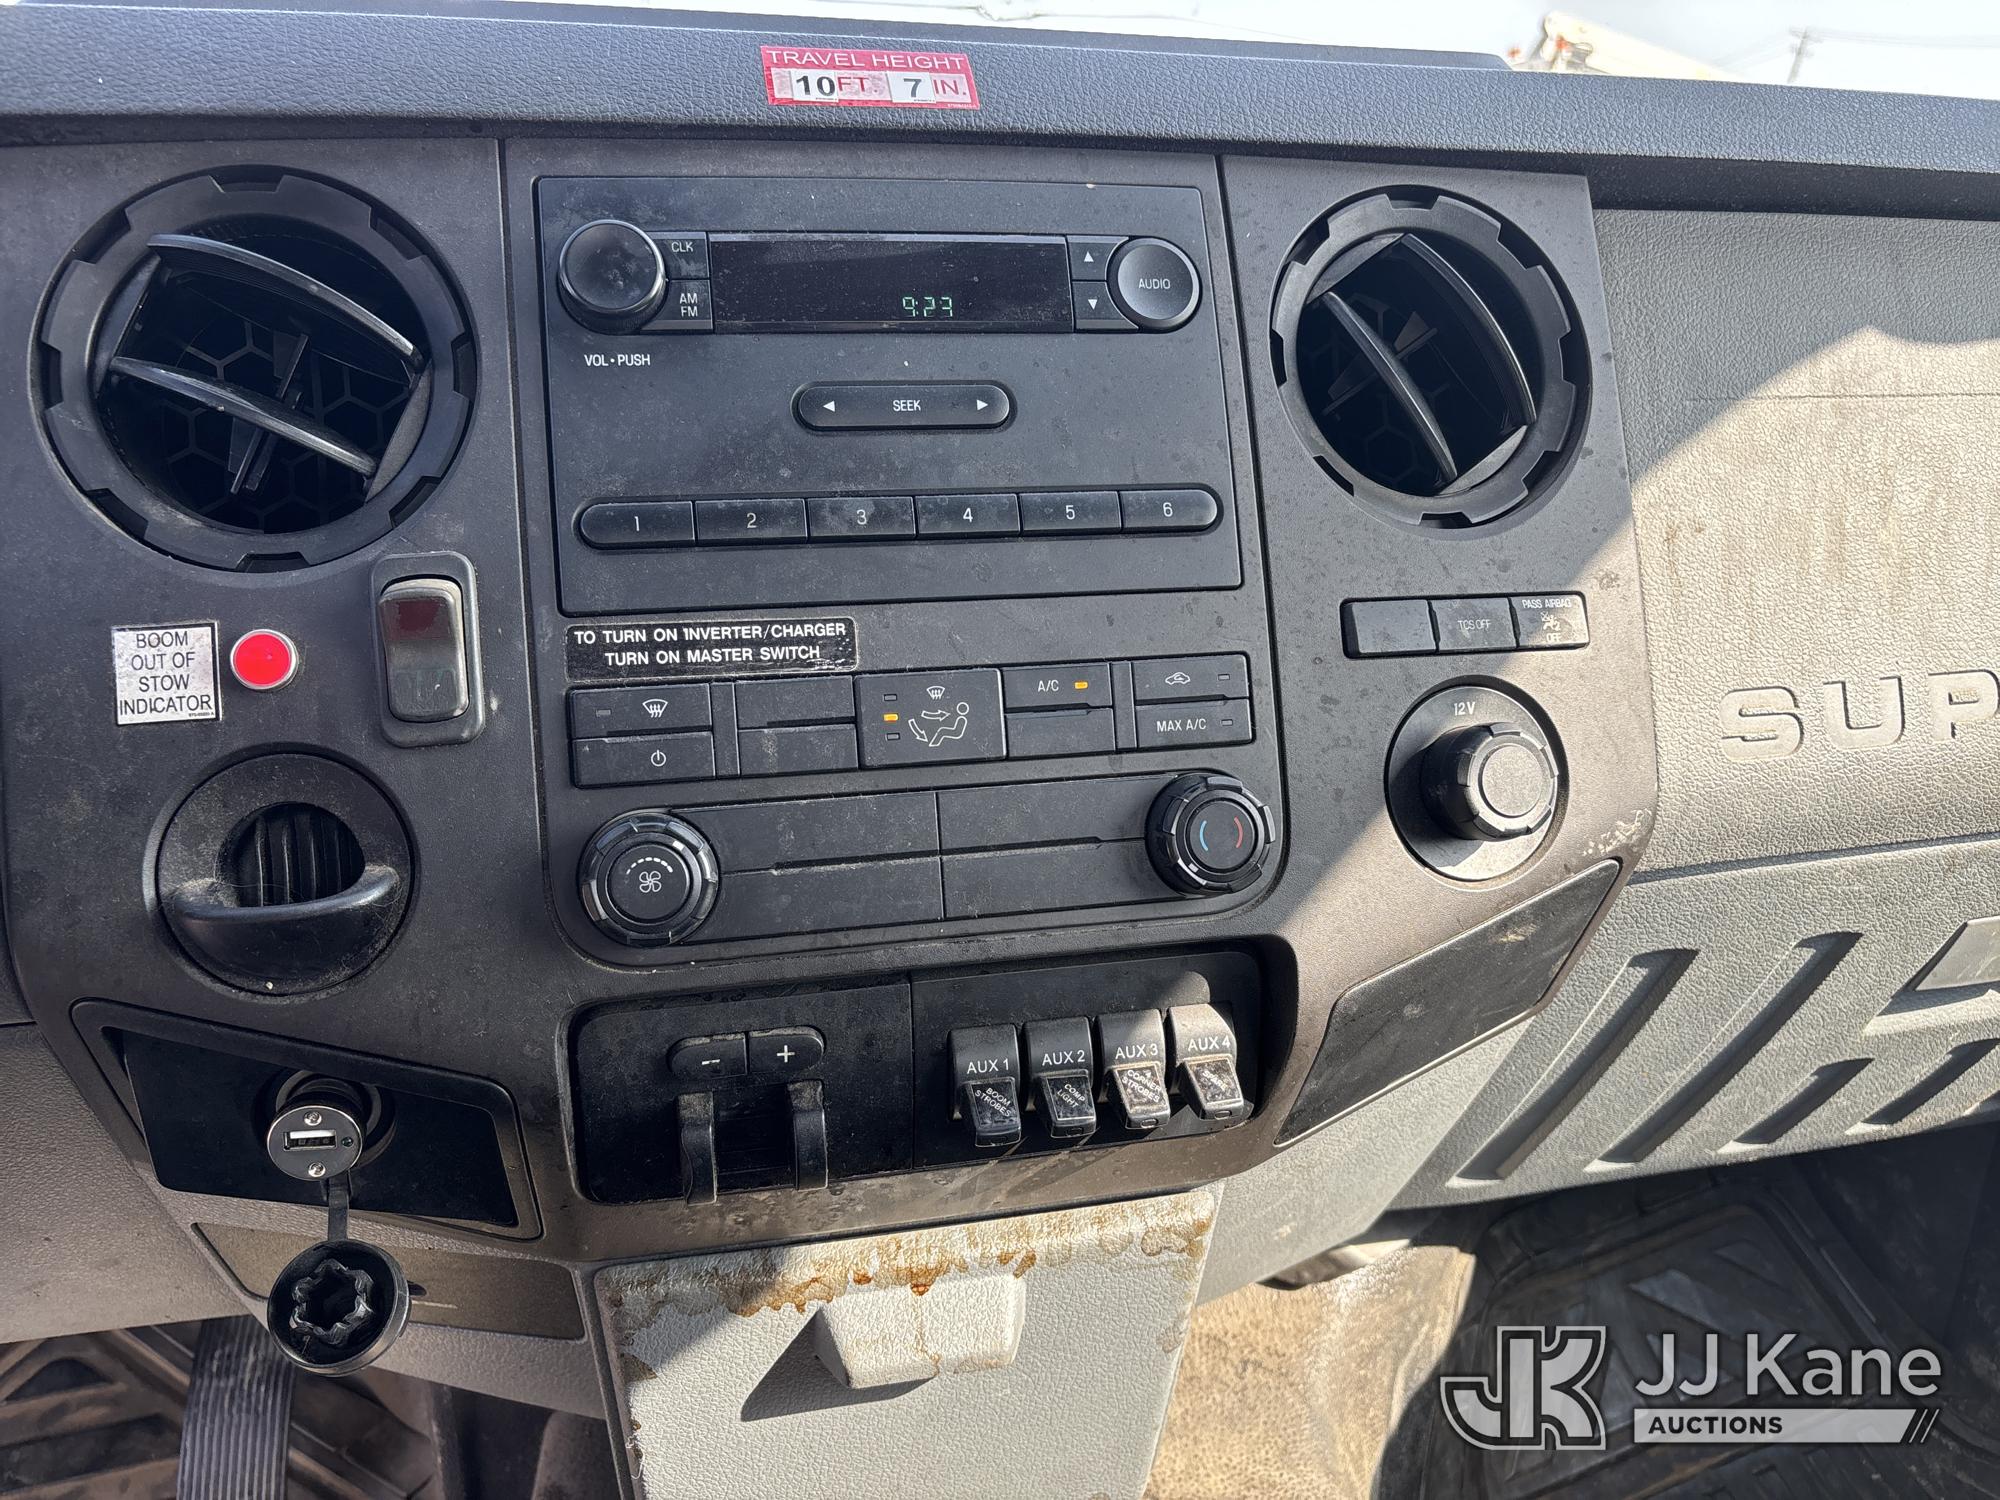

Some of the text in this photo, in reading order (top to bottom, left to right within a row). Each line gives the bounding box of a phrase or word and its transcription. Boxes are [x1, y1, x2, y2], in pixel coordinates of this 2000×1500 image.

[766, 50, 964, 70] TRAVEL HEIGHT
[796, 75, 835, 96] 10
[903, 78, 922, 97] 7
[671, 241, 694, 253] CLK
[1138, 278, 1171, 290] AUDIO
[679, 293, 698, 304] AM
[902, 296, 953, 317] 9:23
[681, 306, 698, 317] FM
[892, 399, 921, 412] SEEK
[634, 502, 1173, 531] 1 2 3 4 5 6
[1521, 598, 1572, 608] PASS AIRBAG
[1458, 619, 1491, 630] TCS OFF
[136, 631, 189, 649] BOOM
[574, 623, 846, 645] TO TURN ON INVERTER/CHARGER
[131, 652, 195, 670] OUT OF
[605, 645, 820, 666] TURN ON MASTER SWITCH
[138, 674, 190, 692] STOW
[1038, 679, 1059, 692] A/C
[119, 694, 213, 716] INDICATOR
[1453, 702, 1475, 716] 12V
[1718, 669, 2000, 762] SUP
[1156, 718, 1207, 733] MAX A/C
[1115, 1043, 1159, 1060] AUX 3
[1187, 1036, 1231, 1051] AUX 4
[967, 1058, 1009, 1074] AUX 1
[1042, 1050, 1085, 1066] AUX 2
[1121, 1076, 1160, 1103] STROBES
[1127, 1070, 1161, 1092] CORNER
[986, 1087, 1011, 1107] BOOM
[1056, 1089, 1079, 1108] LIGHT
[1064, 1083, 1086, 1102] COMP
[975, 1089, 1012, 1117] STROBES
